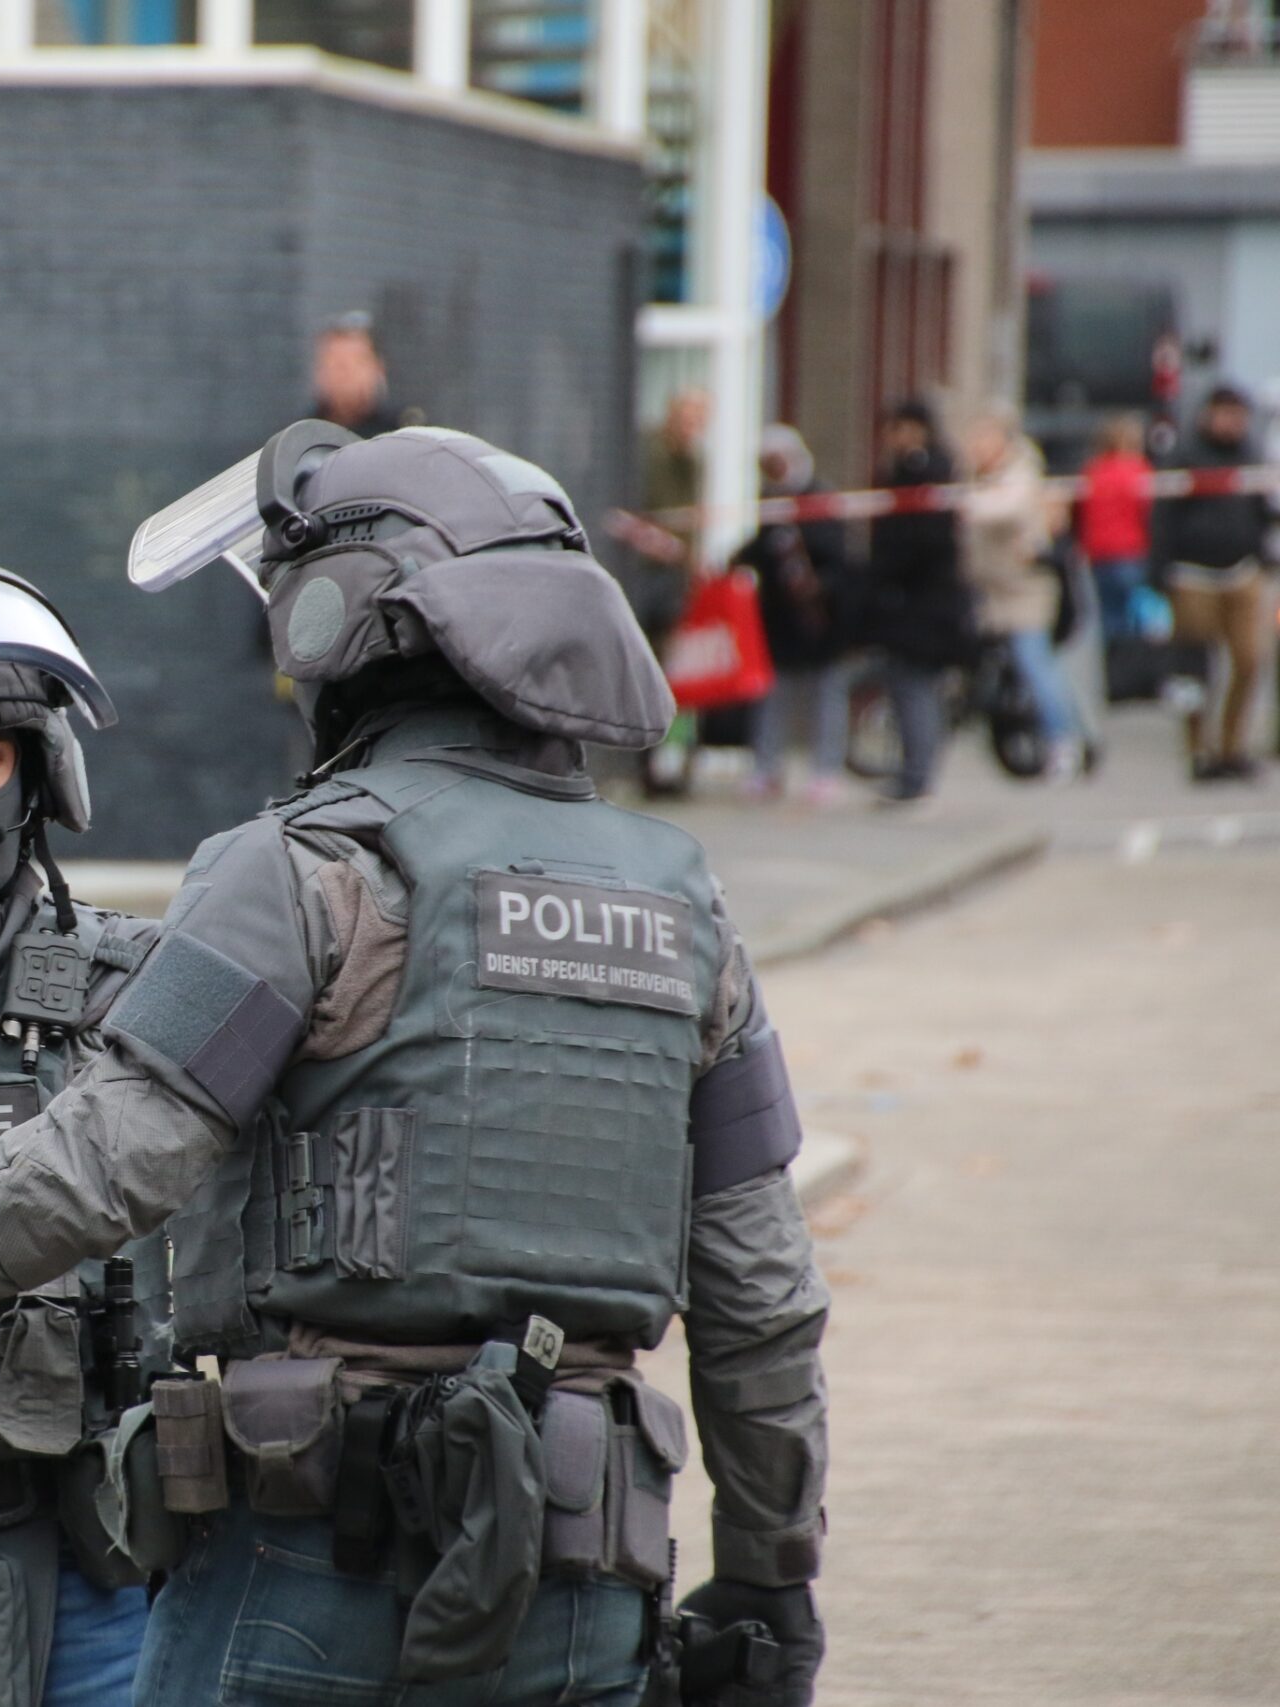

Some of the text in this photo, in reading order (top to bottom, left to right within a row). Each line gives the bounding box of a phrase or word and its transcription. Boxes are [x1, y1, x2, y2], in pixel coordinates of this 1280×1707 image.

[499, 890, 678, 960] POLITIE
[486, 952, 539, 977] DIENST
[542, 958, 607, 984] SPECIALE
